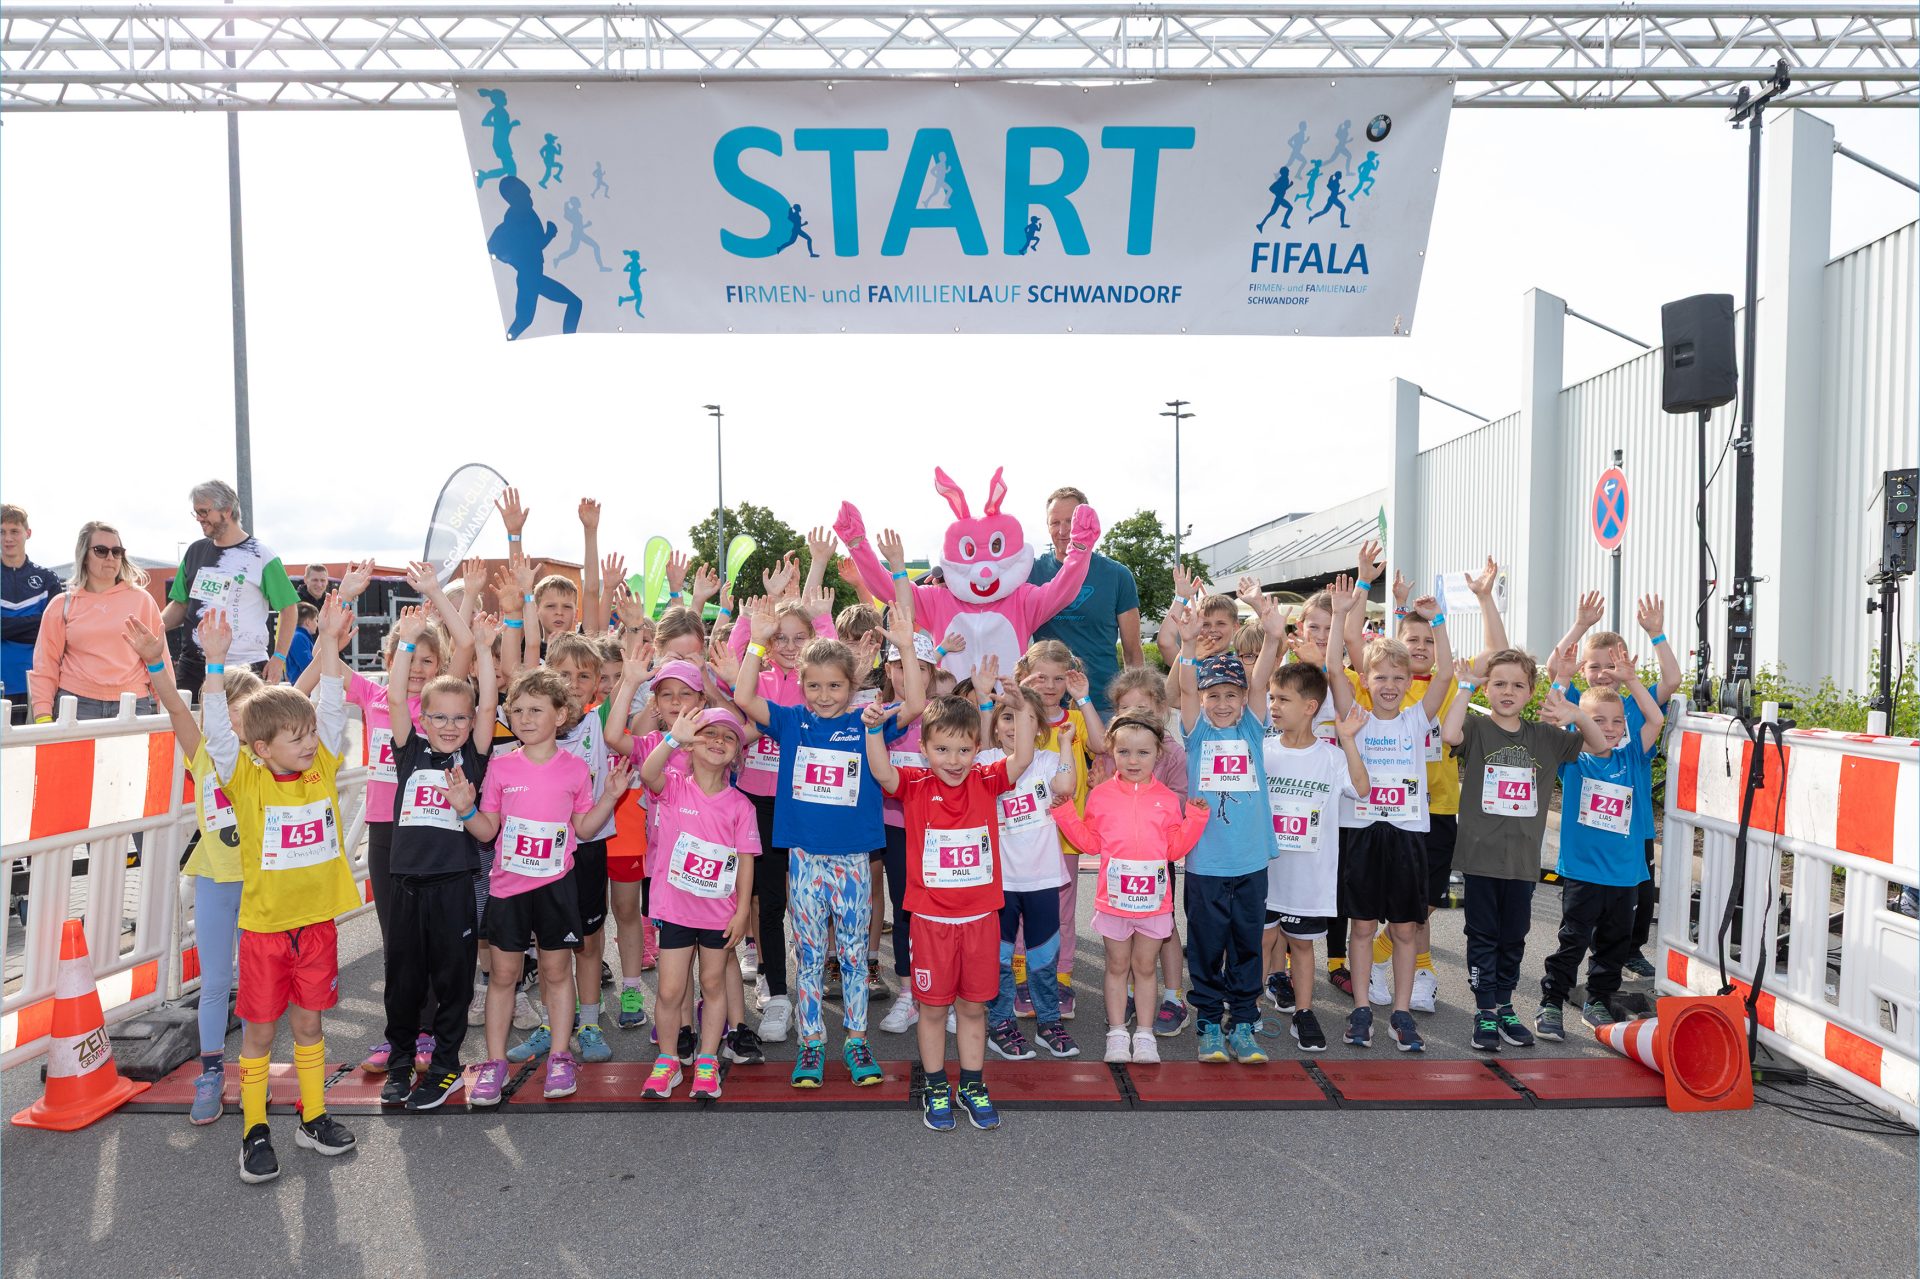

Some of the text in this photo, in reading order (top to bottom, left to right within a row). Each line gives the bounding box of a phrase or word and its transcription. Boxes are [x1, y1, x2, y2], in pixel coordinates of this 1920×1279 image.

[713, 126, 1196, 259] START
[1250, 242, 1369, 275] FIFALA
[726, 284, 1183, 305] FIRMEN- und FAMILIENLAUF SCHWANDORF
[1249, 283, 1368, 294] FIRMEN- und FAMILIENLAUF
[1247, 296, 1310, 305] SCHWANDORF
[201, 580, 221, 595] 245
[232, 587, 243, 632] wasotech
[1220, 756, 1241, 773] 12
[813, 766, 836, 785] 15
[1266, 774, 1331, 793] CHNELLECKE
[420, 787, 446, 806] 30
[813, 786, 831, 794] LENA
[1270, 786, 1314, 798] LOGISTICS
[1376, 788, 1399, 804] 40
[1504, 782, 1527, 799] 44
[422, 808, 440, 816] THEO
[679, 807, 699, 816] CRAFT
[1009, 796, 1030, 815] 25
[1596, 796, 1618, 815] 24
[1013, 813, 1032, 823] MARIE
[1279, 816, 1302, 833] 10
[1598, 814, 1613, 822] LIAS
[288, 822, 317, 845] 45
[1278, 834, 1300, 842] OSKAR
[520, 837, 545, 857] 31
[522, 858, 540, 866] LENA
[948, 847, 974, 866] 16
[689, 855, 716, 878] 28
[952, 868, 971, 876] PAUL
[680, 871, 718, 889] CASSANDRA
[1126, 876, 1150, 893] 42
[1279, 914, 1301, 924] eus
[72, 1024, 108, 1063] ZEIT
